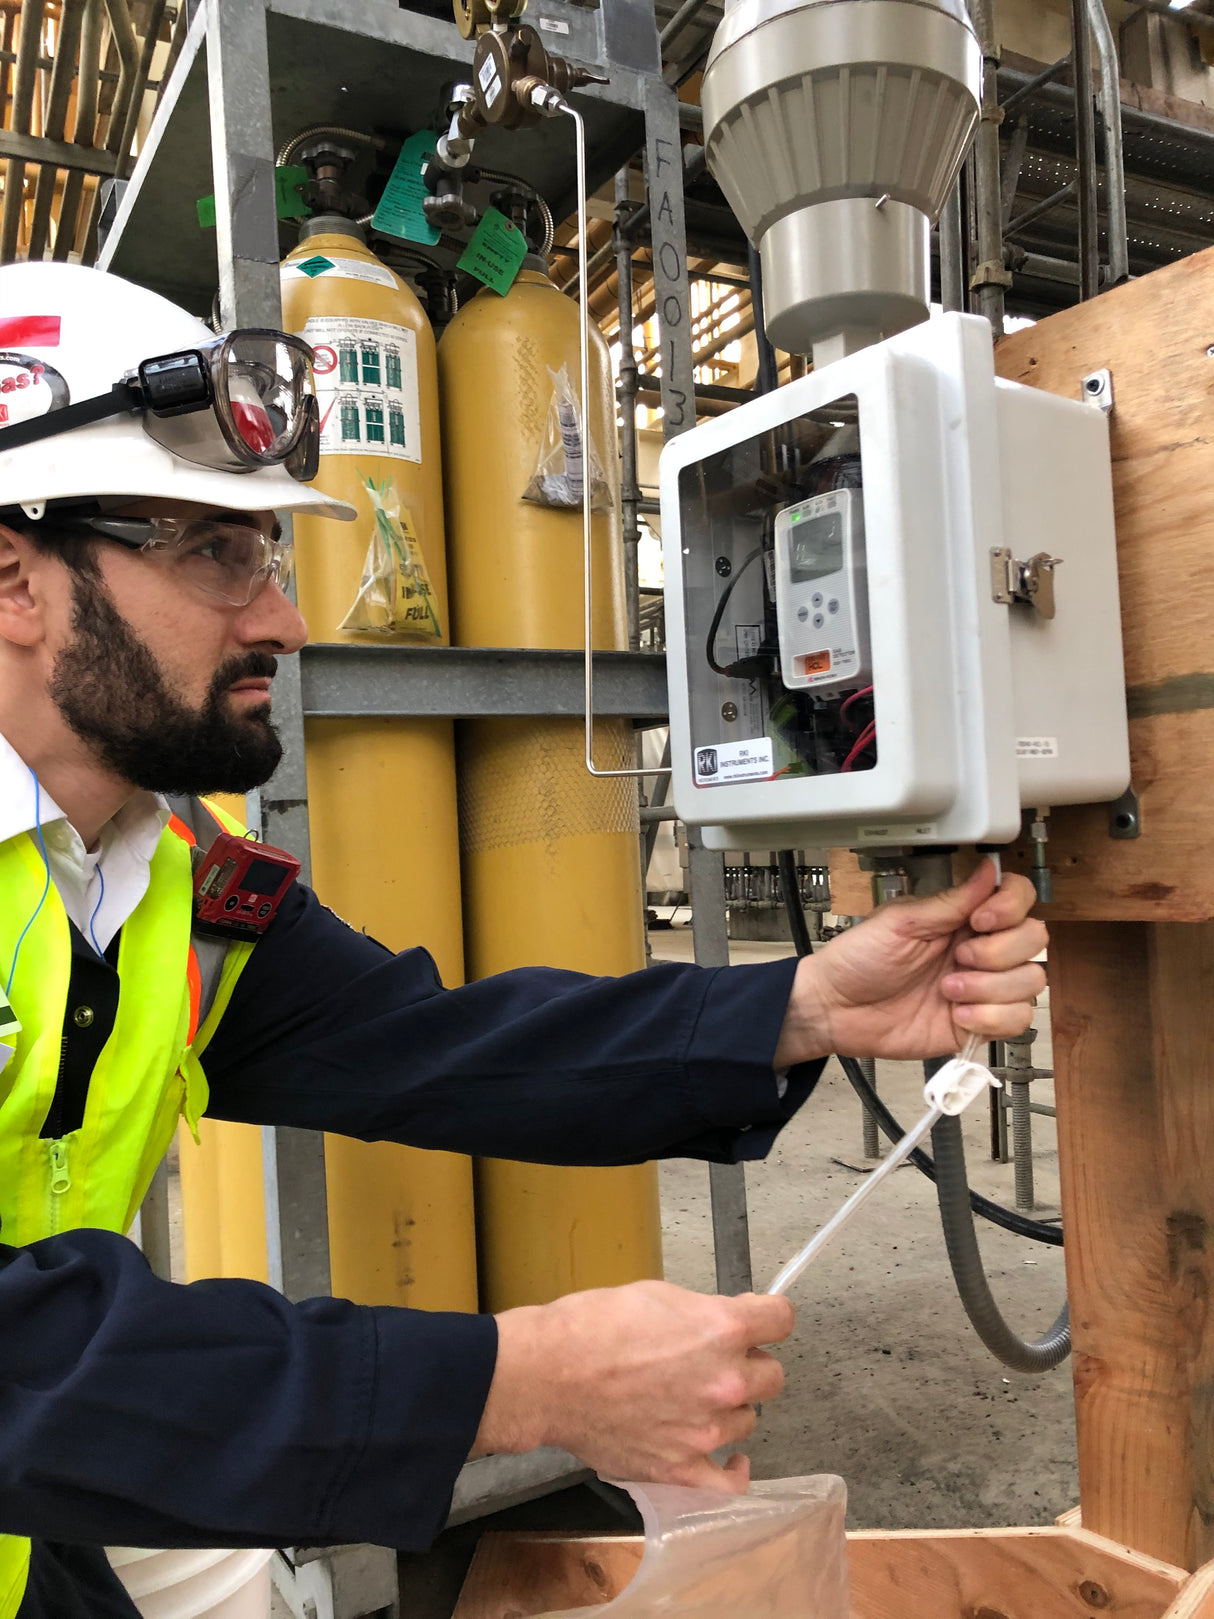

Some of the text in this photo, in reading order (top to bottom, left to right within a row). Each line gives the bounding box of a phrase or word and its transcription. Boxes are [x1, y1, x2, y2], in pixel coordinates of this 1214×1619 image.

[0, 365, 45, 394] as?
[697, 750, 718, 775] RKI
[720, 756, 757, 767] INSTRUMENTS
